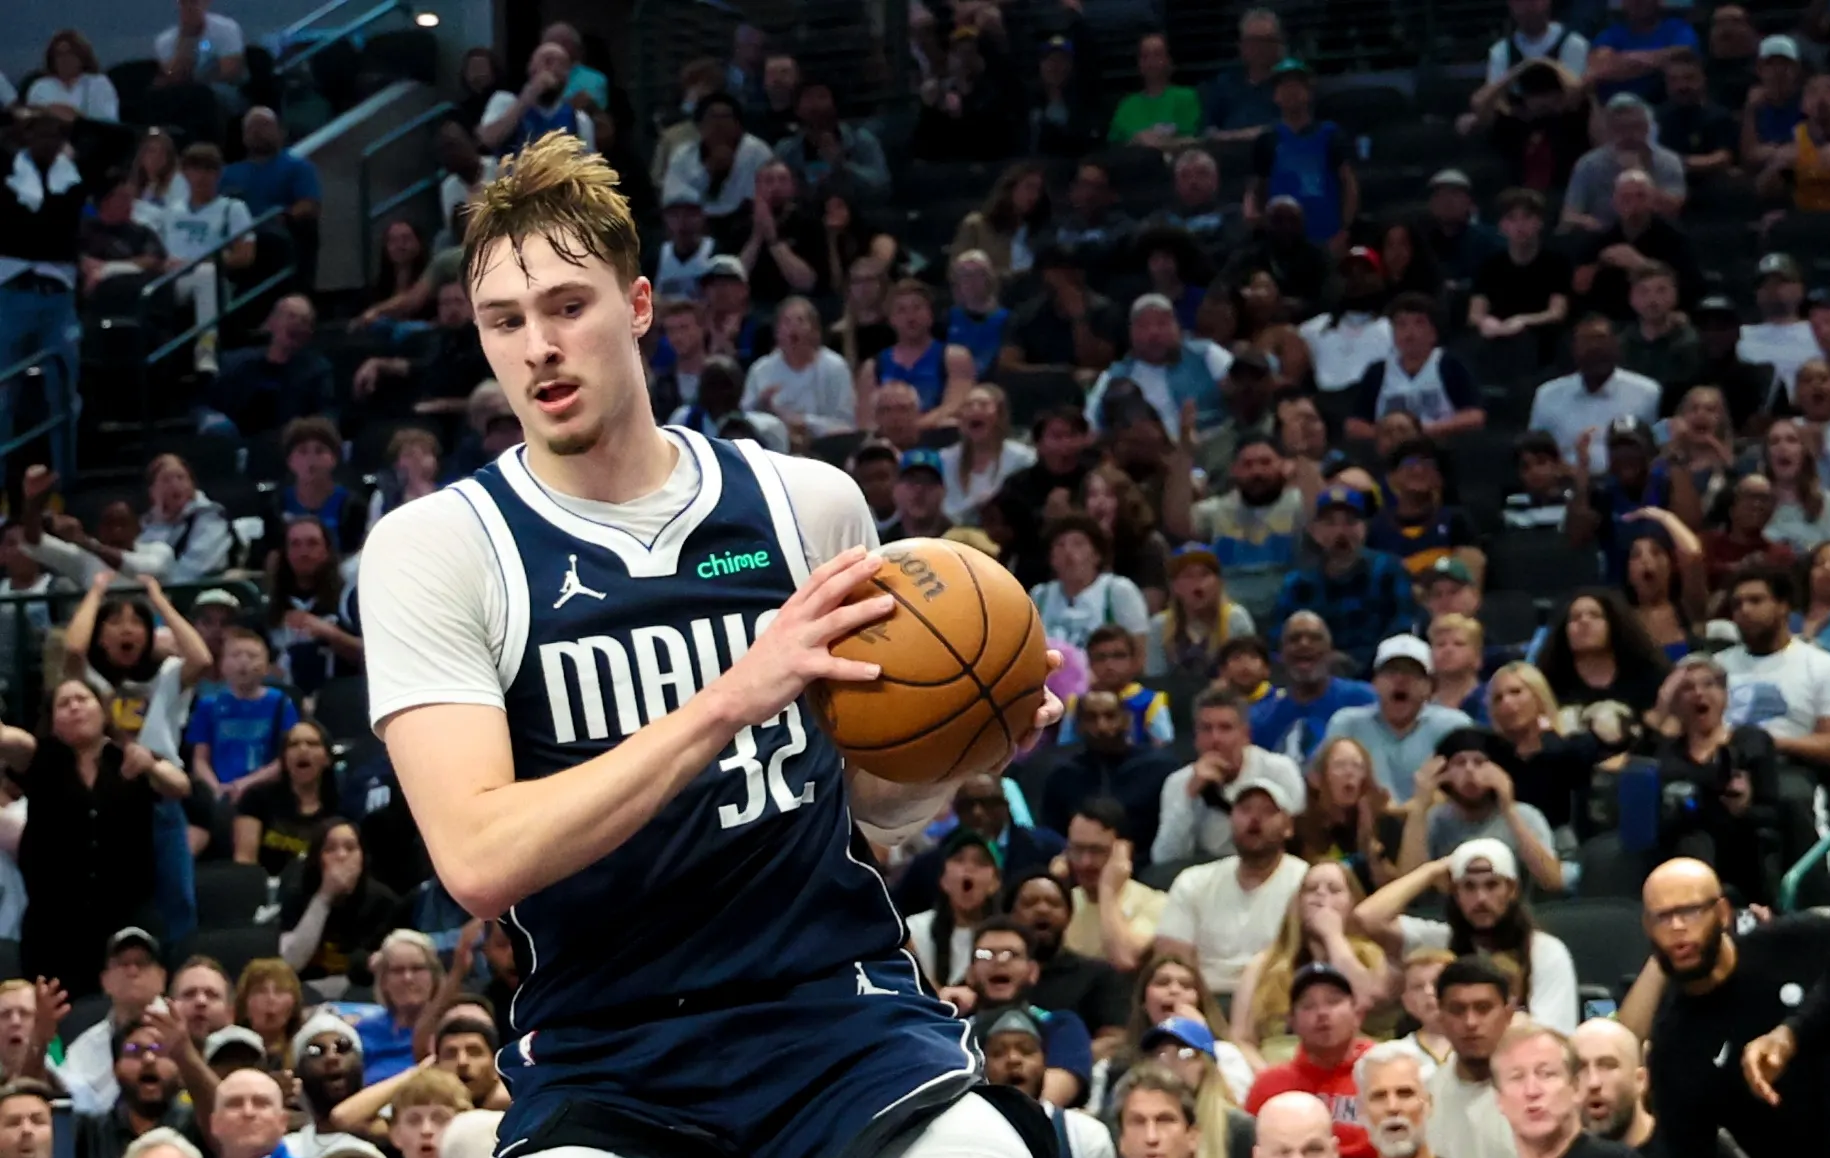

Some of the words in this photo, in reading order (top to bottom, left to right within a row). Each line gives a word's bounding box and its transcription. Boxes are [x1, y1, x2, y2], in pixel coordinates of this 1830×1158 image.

[697, 550, 770, 578] chime
[538, 608, 780, 744] MAV
[718, 700, 815, 829] 32
